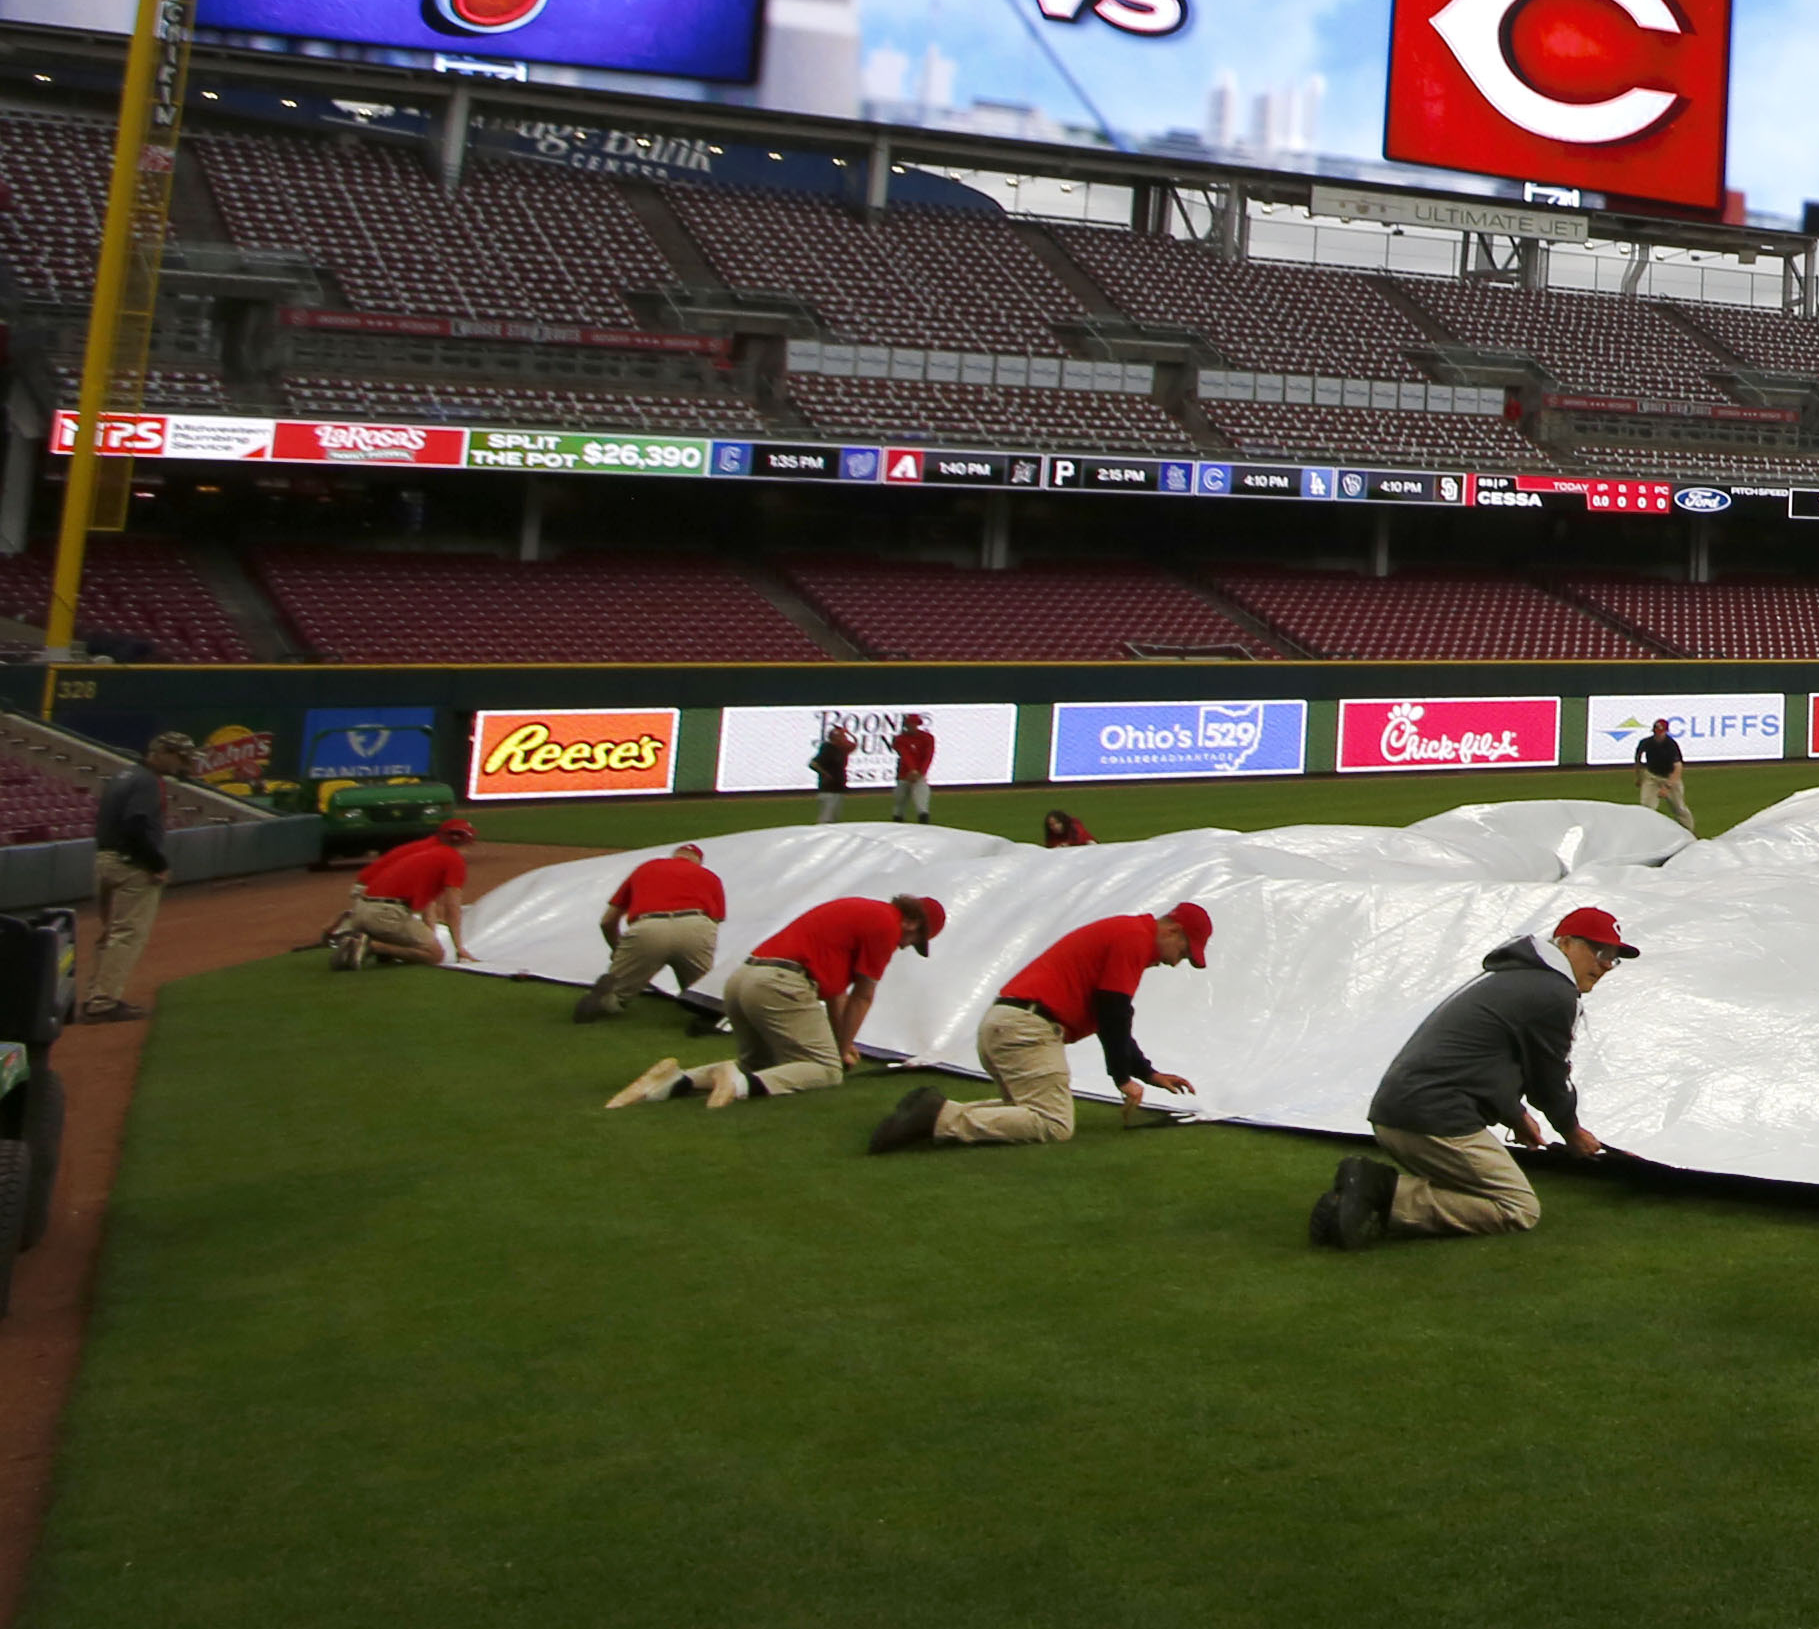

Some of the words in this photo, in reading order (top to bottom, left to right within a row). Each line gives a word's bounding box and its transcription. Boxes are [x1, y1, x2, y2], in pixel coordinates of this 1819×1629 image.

[1414, 203, 1533, 233] ULTIMATE
[1539, 218, 1584, 237] JET
[315, 425, 427, 451] LaRosa's
[487, 433, 562, 450] SPLIT
[470, 449, 522, 467] THE
[525, 453, 580, 469] POT
[582, 440, 702, 471] $26,390
[1477, 490, 1543, 508] CESSA
[1552, 481, 1590, 492] TODAY
[1596, 482, 1609, 492] IP
[1618, 483, 1627, 493] B
[1638, 485, 1648, 494] S
[1654, 486, 1670, 495] PC
[1731, 486, 1758, 496] PITCH
[1758, 487, 1789, 497] SPEED
[1683, 491, 1722, 510] Ford
[59, 680, 98, 700] 328
[1100, 725, 1193, 750] Ohio's
[1205, 722, 1256, 749] 529
[1665, 714, 1780, 739] CLIFFS
[483, 721, 665, 776] Reese's
